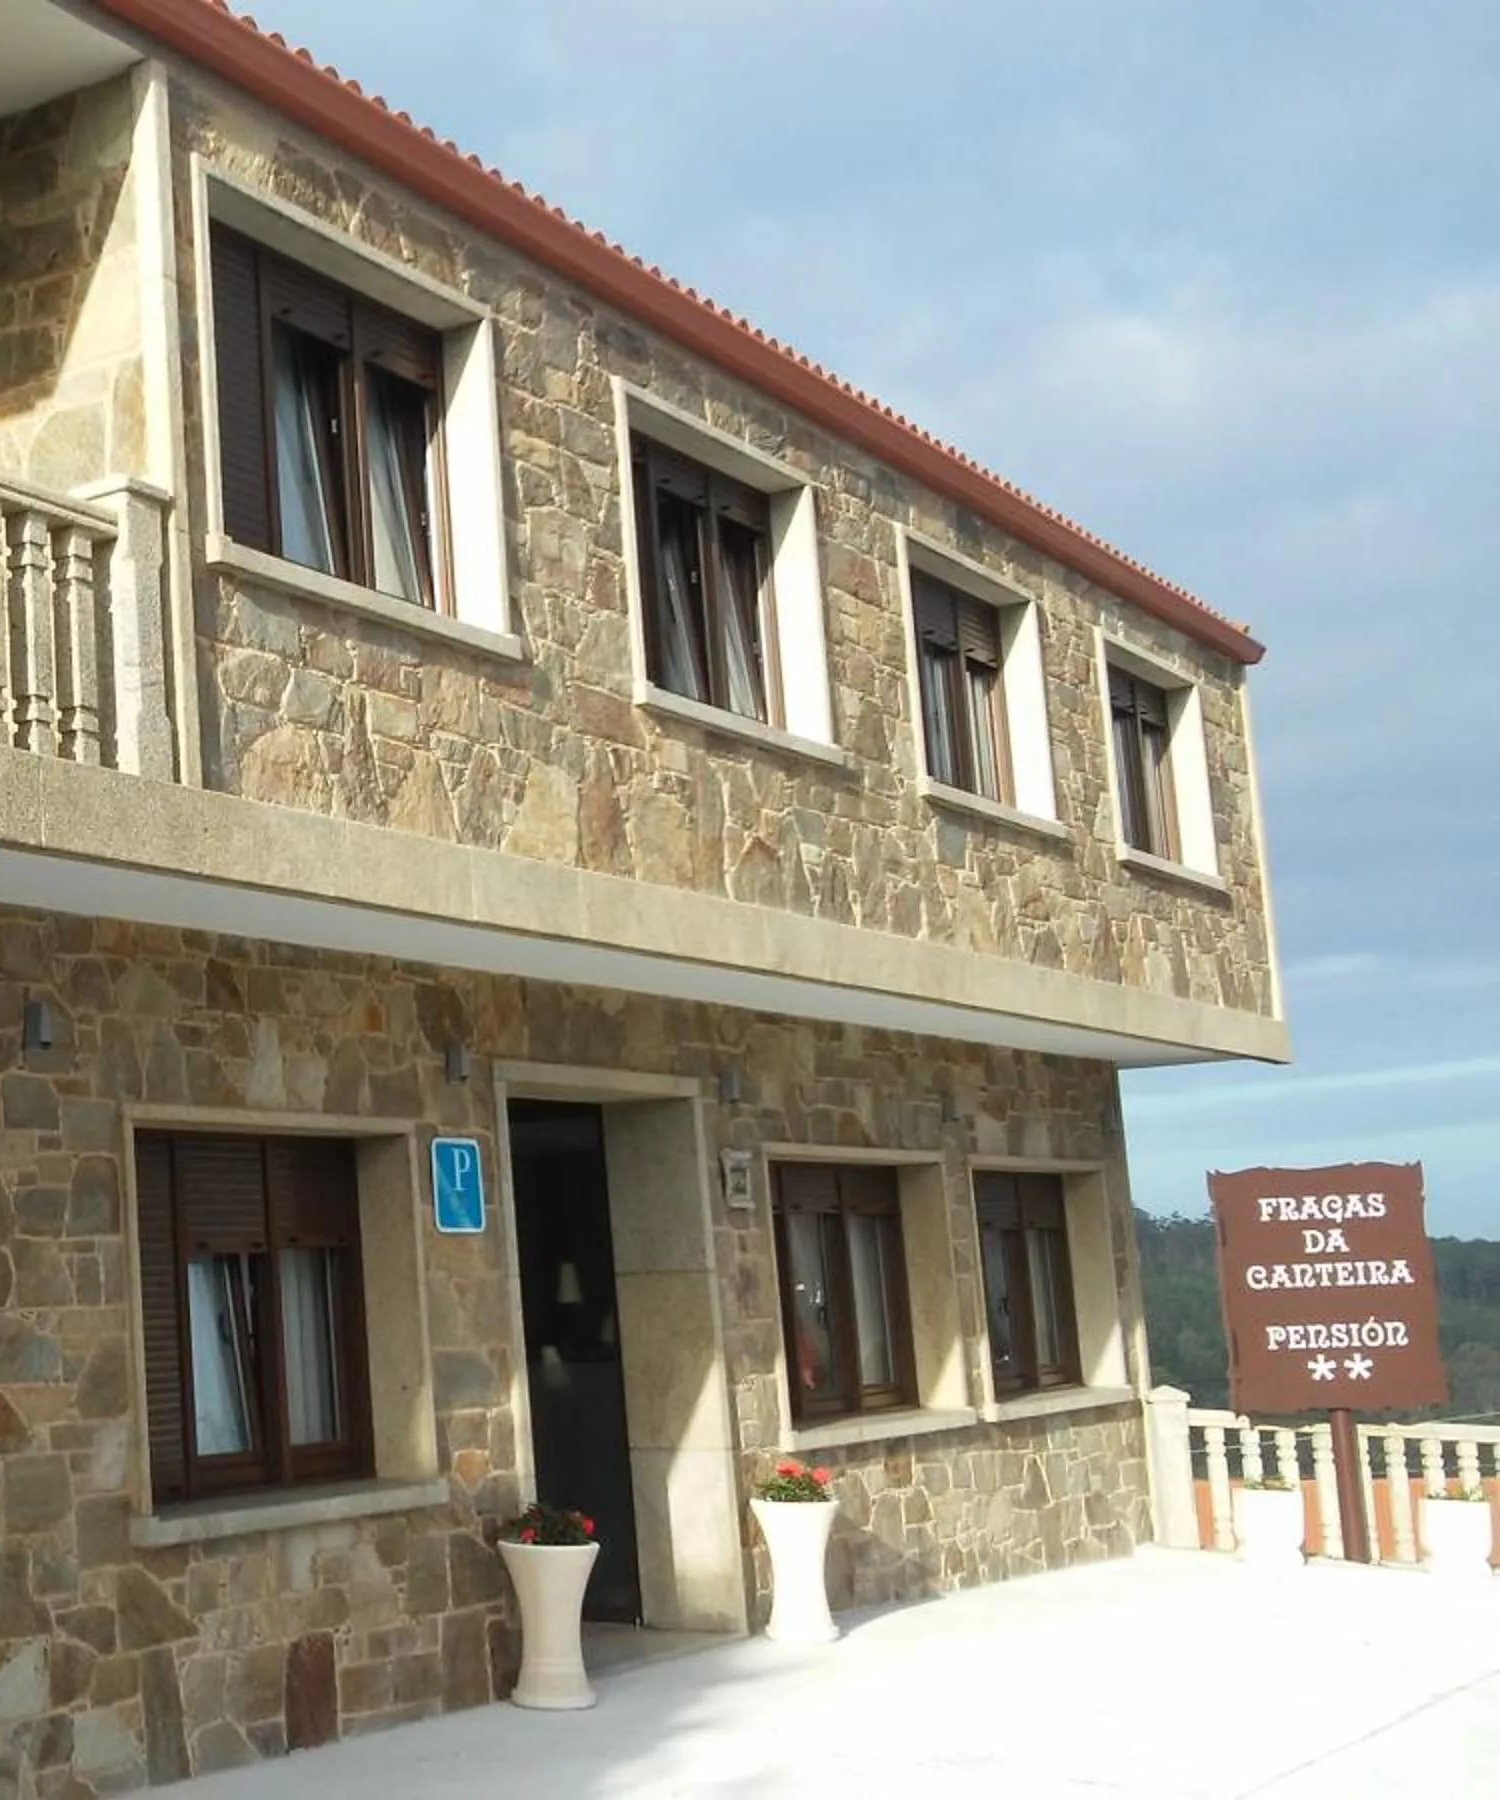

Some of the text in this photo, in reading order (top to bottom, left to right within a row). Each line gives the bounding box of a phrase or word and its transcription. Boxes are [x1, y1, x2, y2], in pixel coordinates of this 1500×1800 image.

[451, 1147, 471, 1192] P
[1257, 1193, 1387, 1223] FRAGAS
[1302, 1228, 1350, 1254] DA
[1246, 1259, 1415, 1290] CANTEIRA
[1265, 1315, 1409, 1350] PENSIÓN
